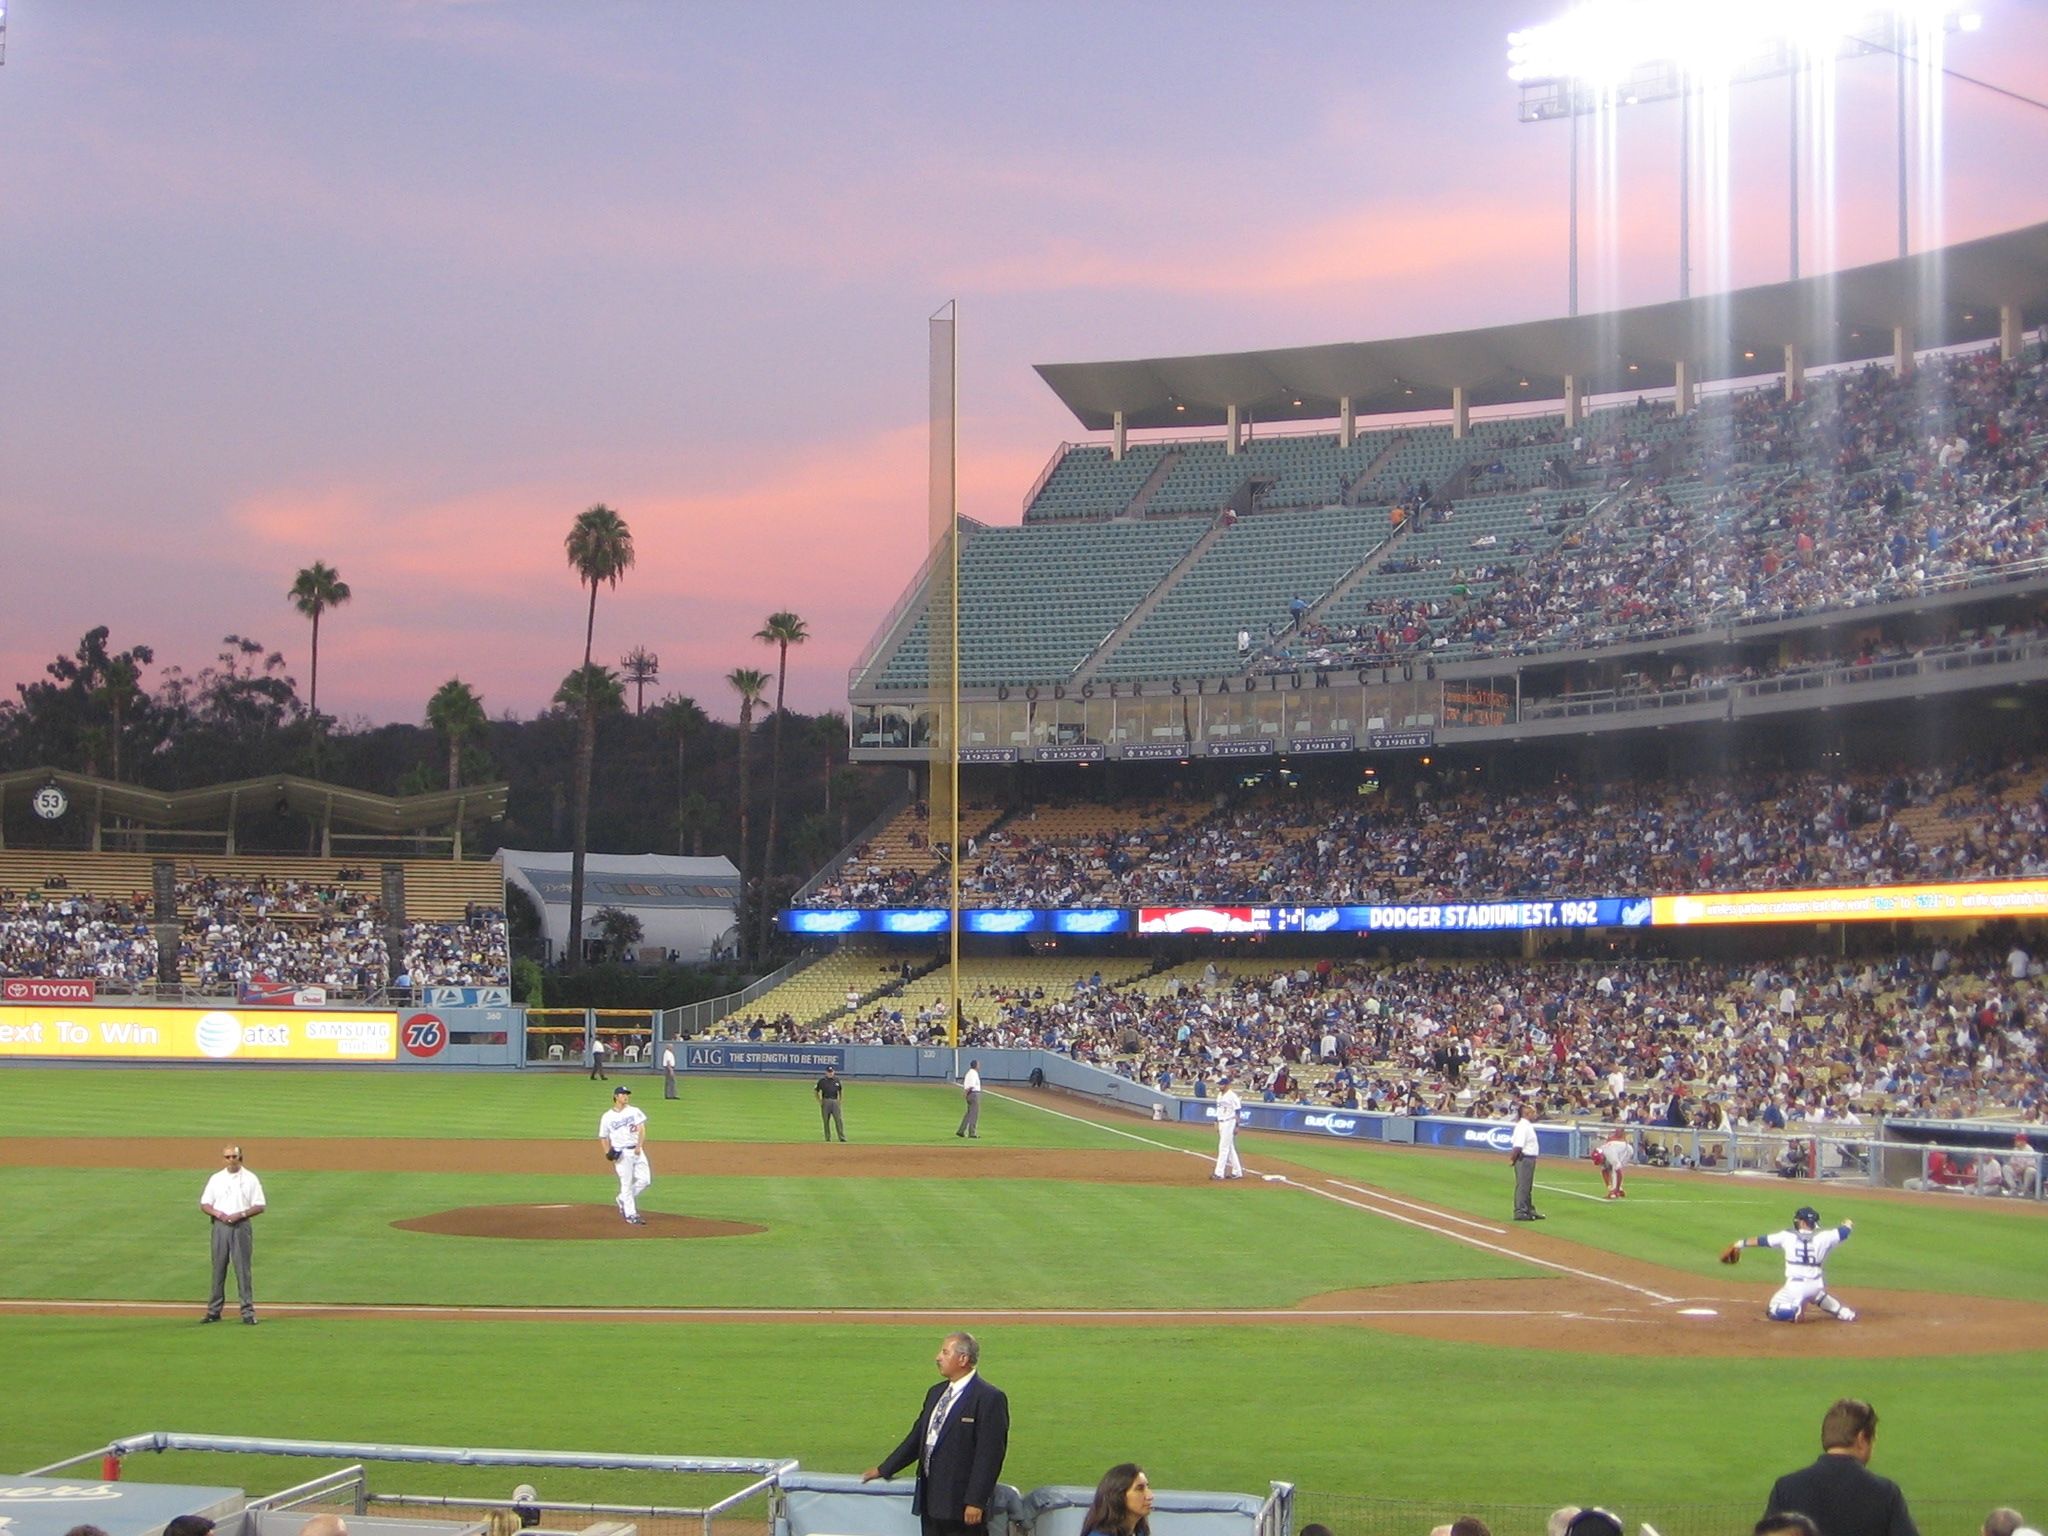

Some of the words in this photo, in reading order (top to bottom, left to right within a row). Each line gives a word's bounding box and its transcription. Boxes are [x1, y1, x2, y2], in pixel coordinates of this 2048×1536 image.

[998, 683, 1142, 700] DODGER
[1171, 671, 1329, 696] STADIUM
[1357, 664, 1435, 685] CLUB
[41, 794, 60, 808] 53
[1370, 907, 1441, 929] DODGER
[1445, 904, 1519, 928] STADIUM
[1522, 902, 1558, 926] EST.
[1560, 901, 1598, 925] 1962
[30, 984, 90, 998] TOYOTA
[55, 1020, 89, 1044] To
[100, 1022, 158, 1044] Win
[244, 1027, 287, 1044] at&t
[308, 1023, 388, 1037] SAMSUNG
[407, 1021, 440, 1048] 76
[692, 1049, 722, 1065] AIG
[729, 1052, 744, 1063] THE
[746, 1052, 788, 1064] STRENGTH
[789, 1053, 800, 1064] TO
[801, 1054, 812, 1065] BE
